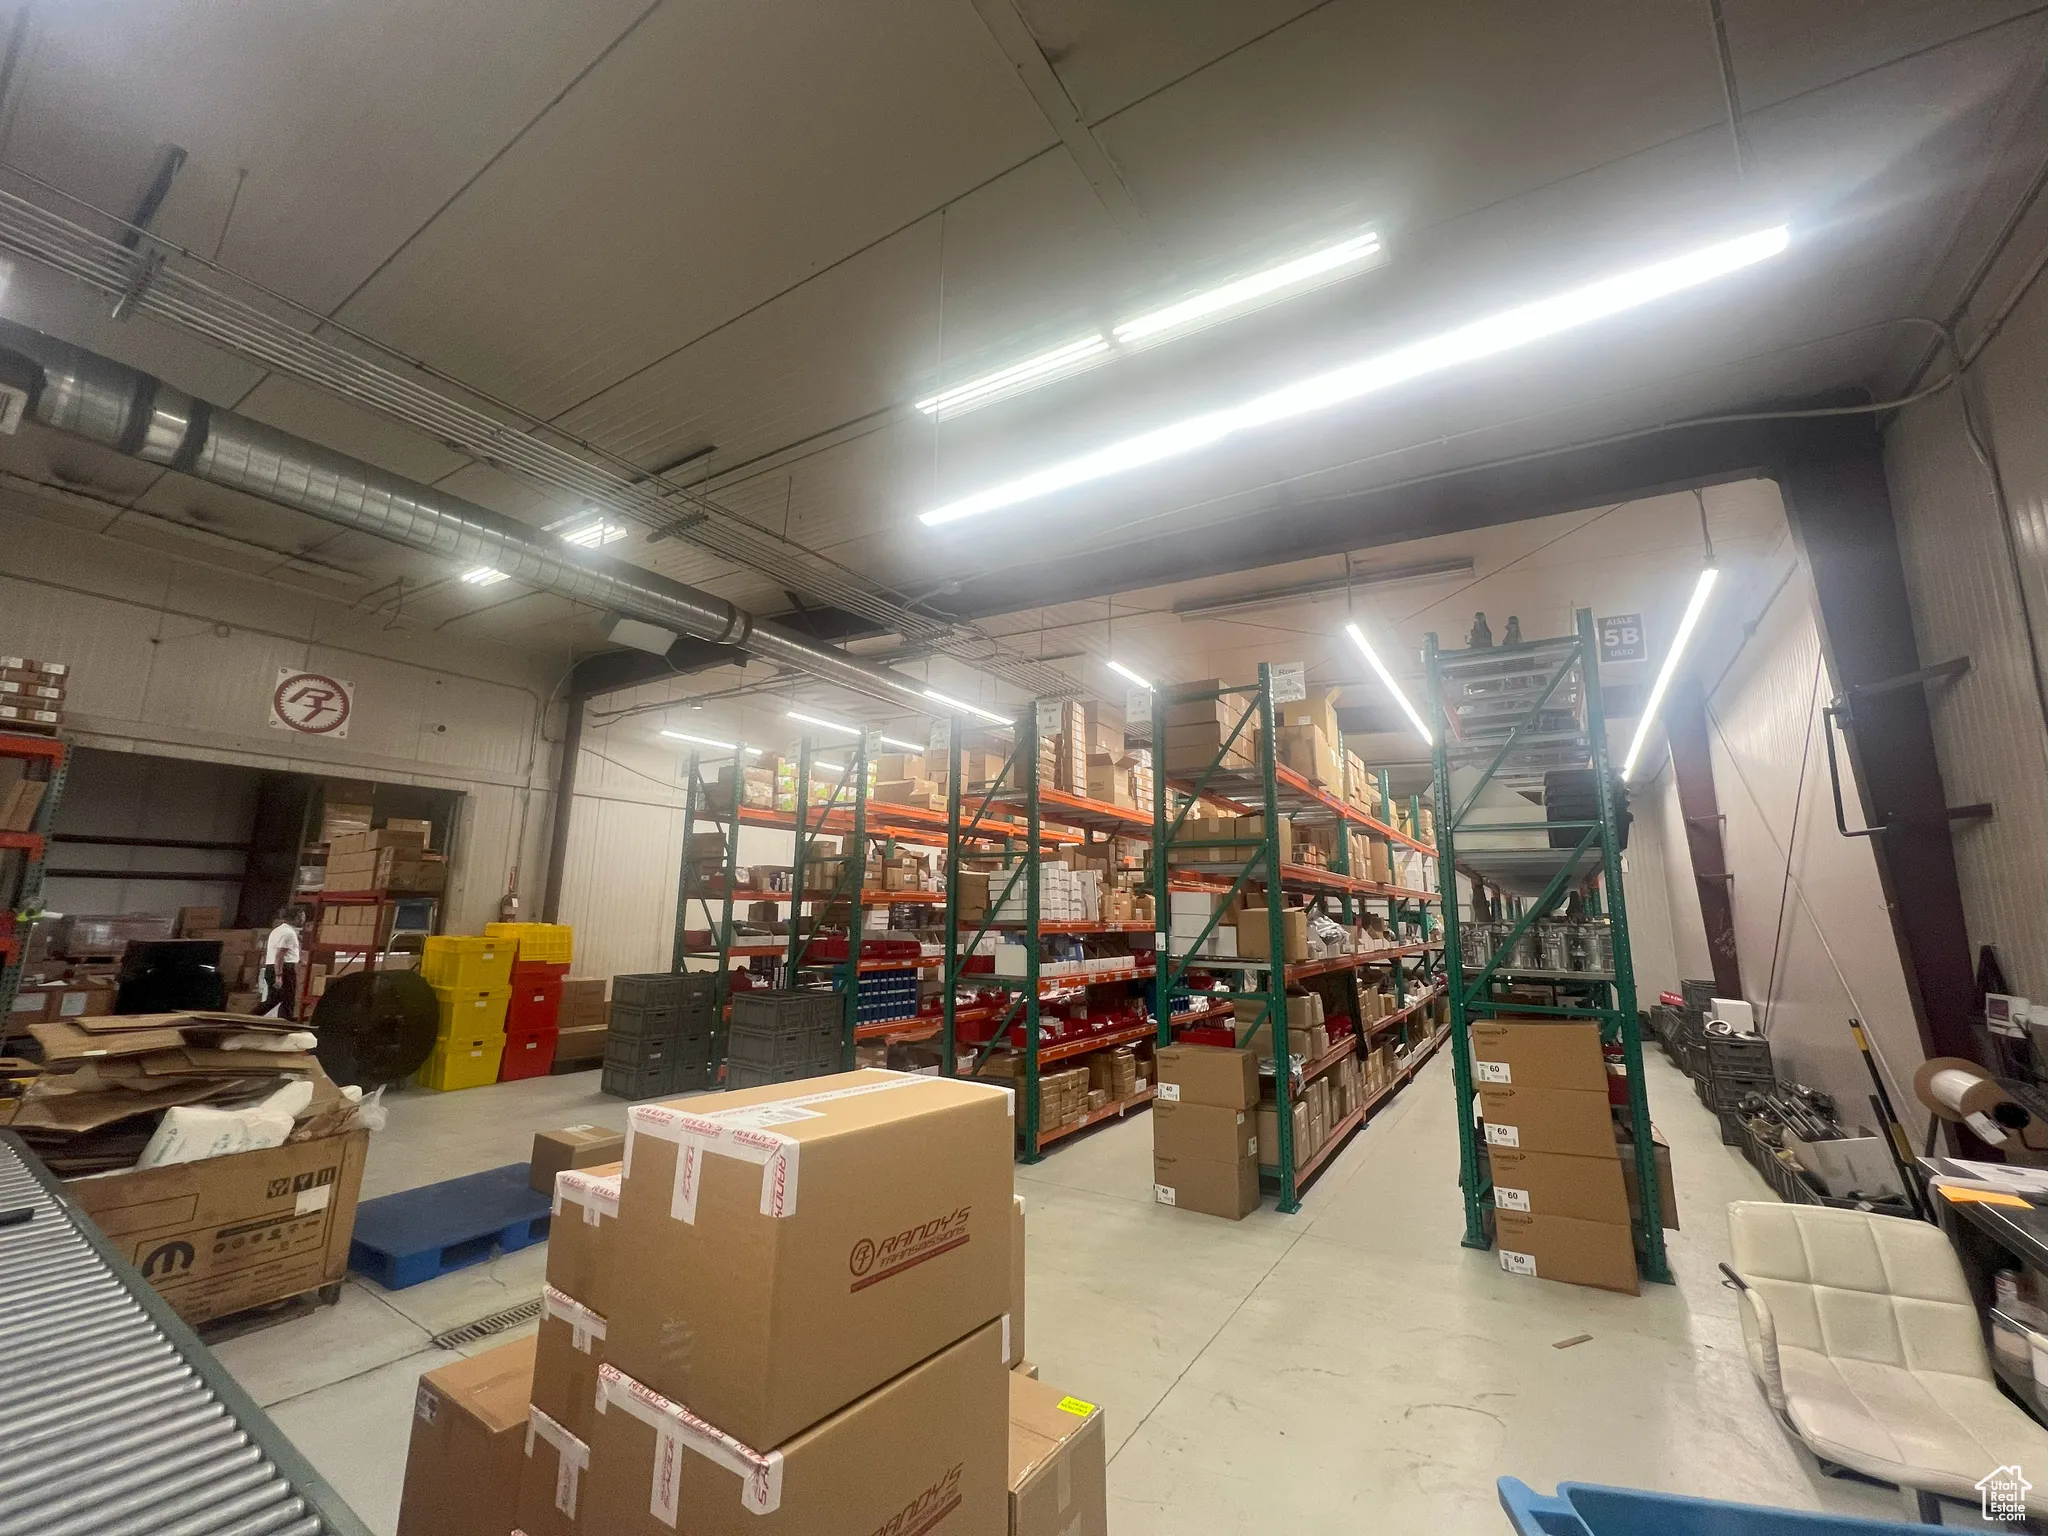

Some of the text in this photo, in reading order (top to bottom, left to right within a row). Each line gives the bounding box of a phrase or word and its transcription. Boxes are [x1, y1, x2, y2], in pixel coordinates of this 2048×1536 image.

[1606, 617, 1633, 626] AISLE
[1604, 627, 1640, 647] 5B
[1610, 649, 1634, 657] USED
[1489, 1065, 1500, 1073] 60
[1497, 1127, 1508, 1136] 60
[1507, 1191, 1518, 1200] 60
[1513, 1255, 1524, 1264] 60
